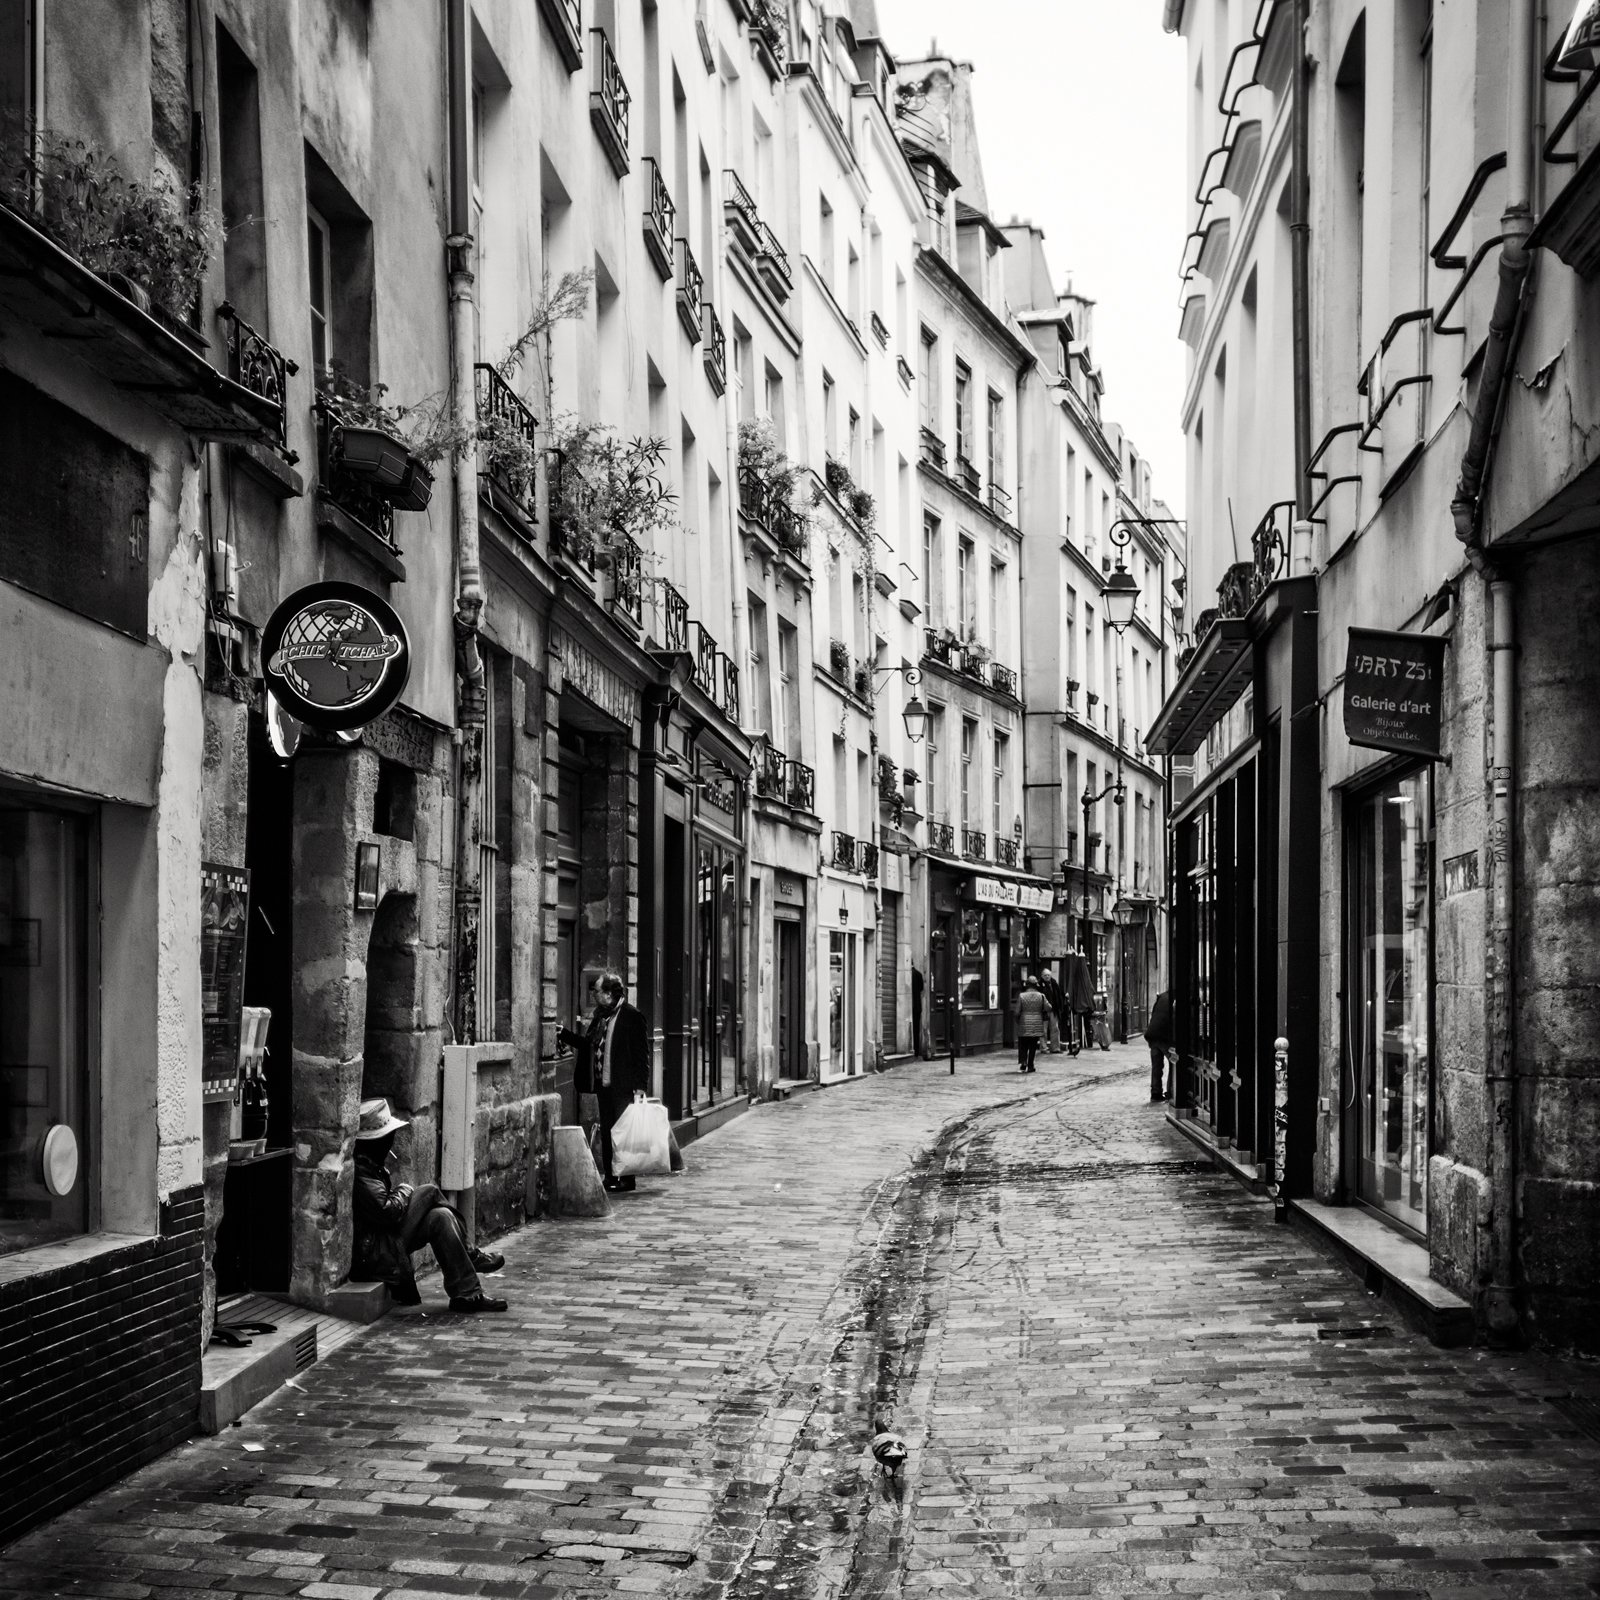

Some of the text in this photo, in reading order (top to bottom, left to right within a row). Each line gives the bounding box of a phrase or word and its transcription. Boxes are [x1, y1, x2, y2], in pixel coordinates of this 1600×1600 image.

[277, 643, 390, 663] TCHIK TCHAK
[1350, 695, 1432, 714] Galerie d'art
[1375, 717, 1405, 729] Bijoux
[1363, 727, 1389, 738] Objets
